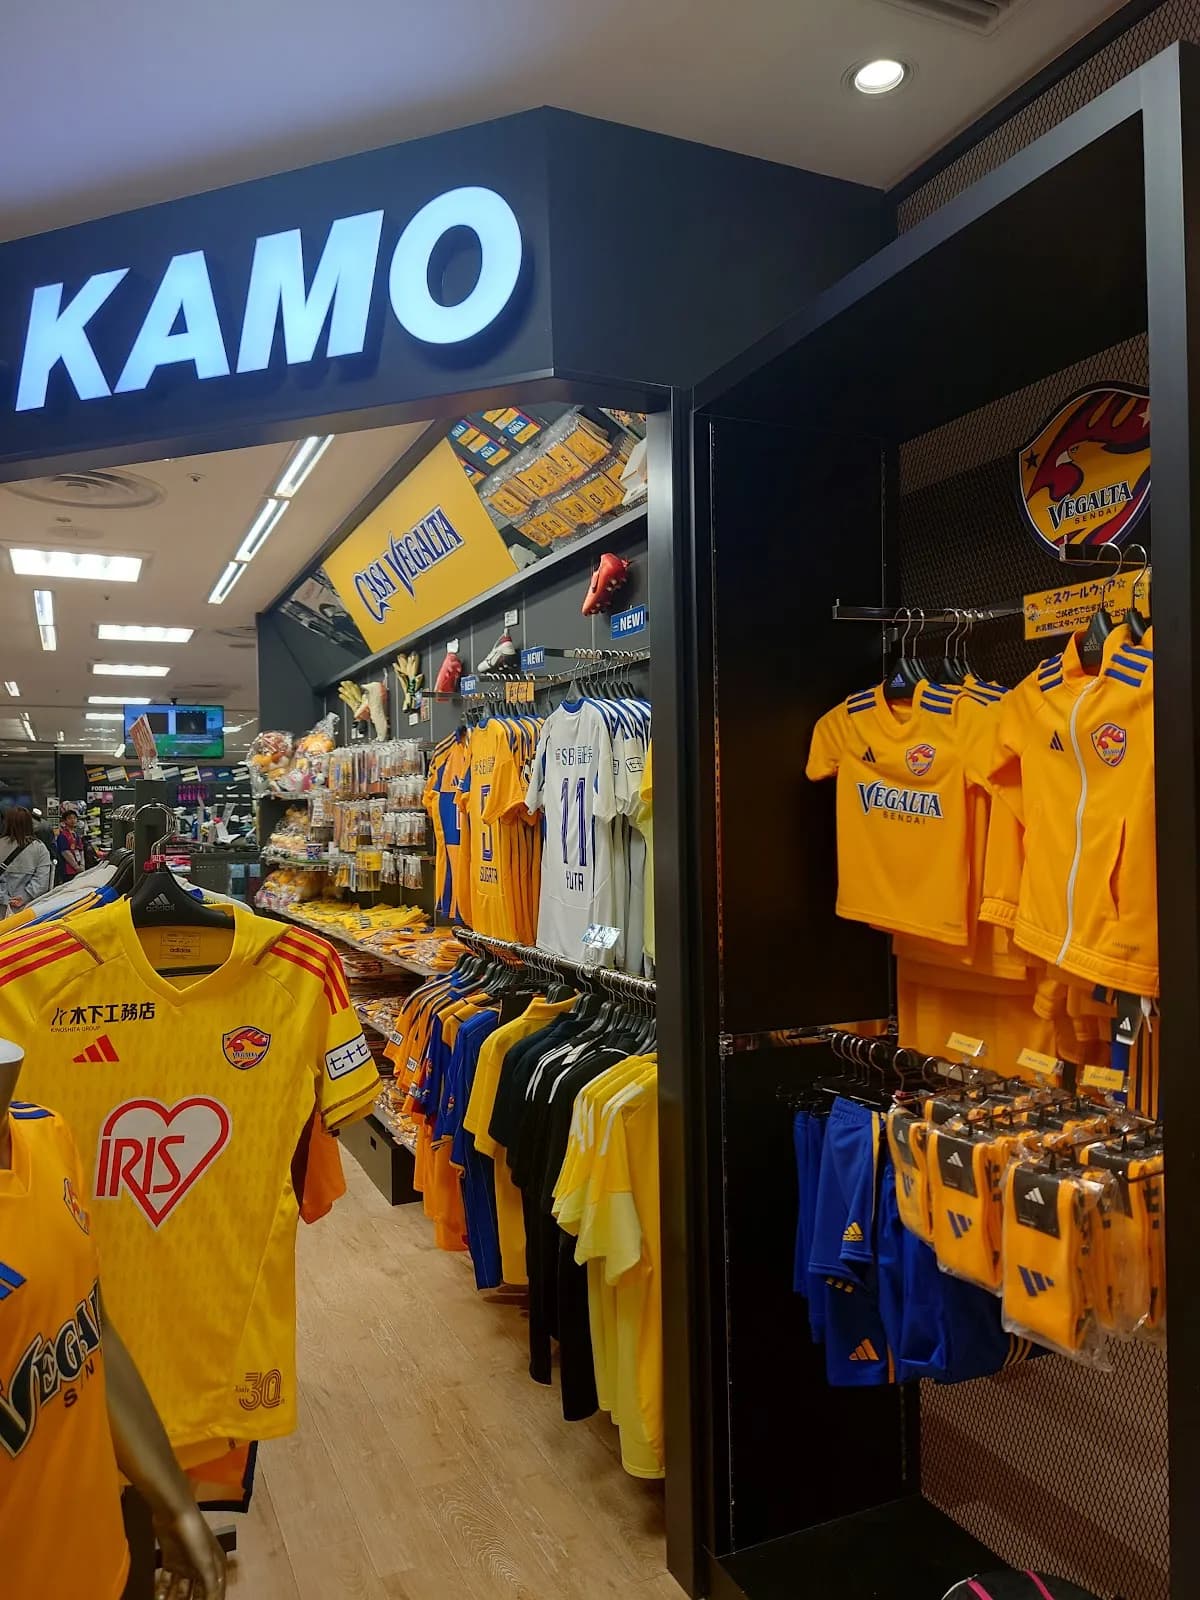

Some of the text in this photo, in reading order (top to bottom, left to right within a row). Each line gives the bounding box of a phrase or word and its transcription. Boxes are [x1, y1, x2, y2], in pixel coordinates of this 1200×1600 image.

[15, 186, 522, 411] KAMO
[1048, 480, 1133, 531] VEGALTA
[1074, 506, 1118, 525] SENDAI
[353, 504, 465, 623] CASA VEGALTA
[619, 611, 644, 632] NEW!
[527, 650, 544, 665] NEW!
[856, 780, 945, 820] VEGALTA
[560, 777, 587, 867] 11
[883, 811, 926, 825] SENDAI
[565, 871, 584, 893] YUTA
[70, 1001, 156, 1025] 木下工務店
[96, 1135, 185, 1197] IRIS
